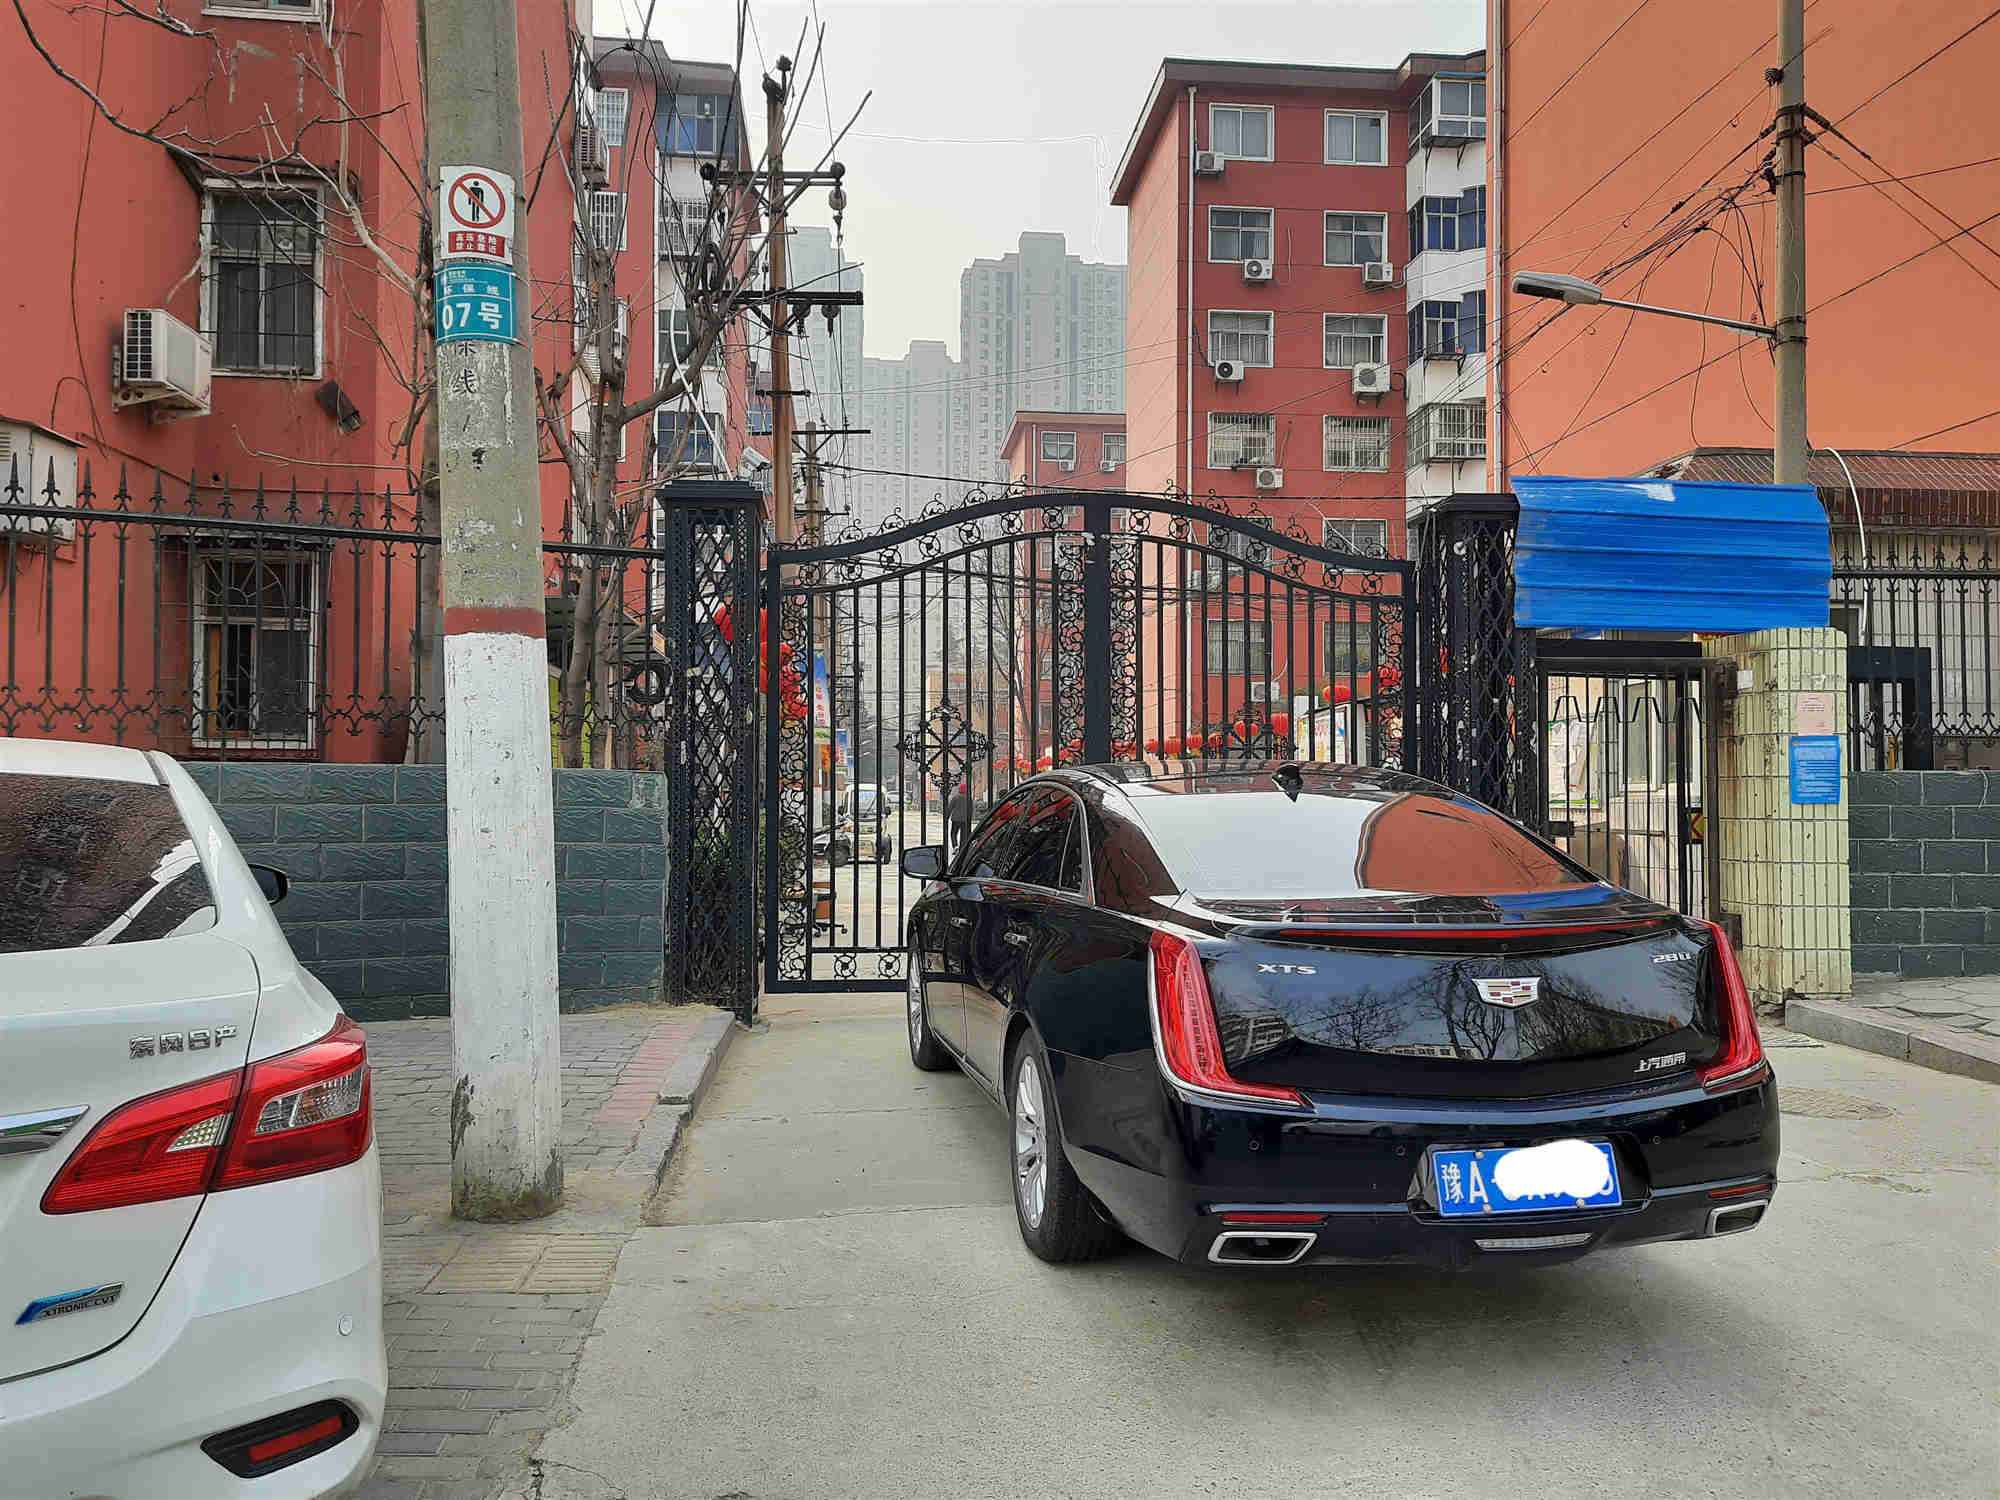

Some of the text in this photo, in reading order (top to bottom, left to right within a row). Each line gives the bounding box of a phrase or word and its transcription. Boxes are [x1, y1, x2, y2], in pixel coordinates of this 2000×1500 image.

[442, 302, 504, 330] 07号
[1257, 962, 1317, 976] XTS
[129, 1024, 238, 1060] 东风日产
[1633, 1051, 1687, 1073] 上汽通用
[94, 1295, 117, 1307] CVT
